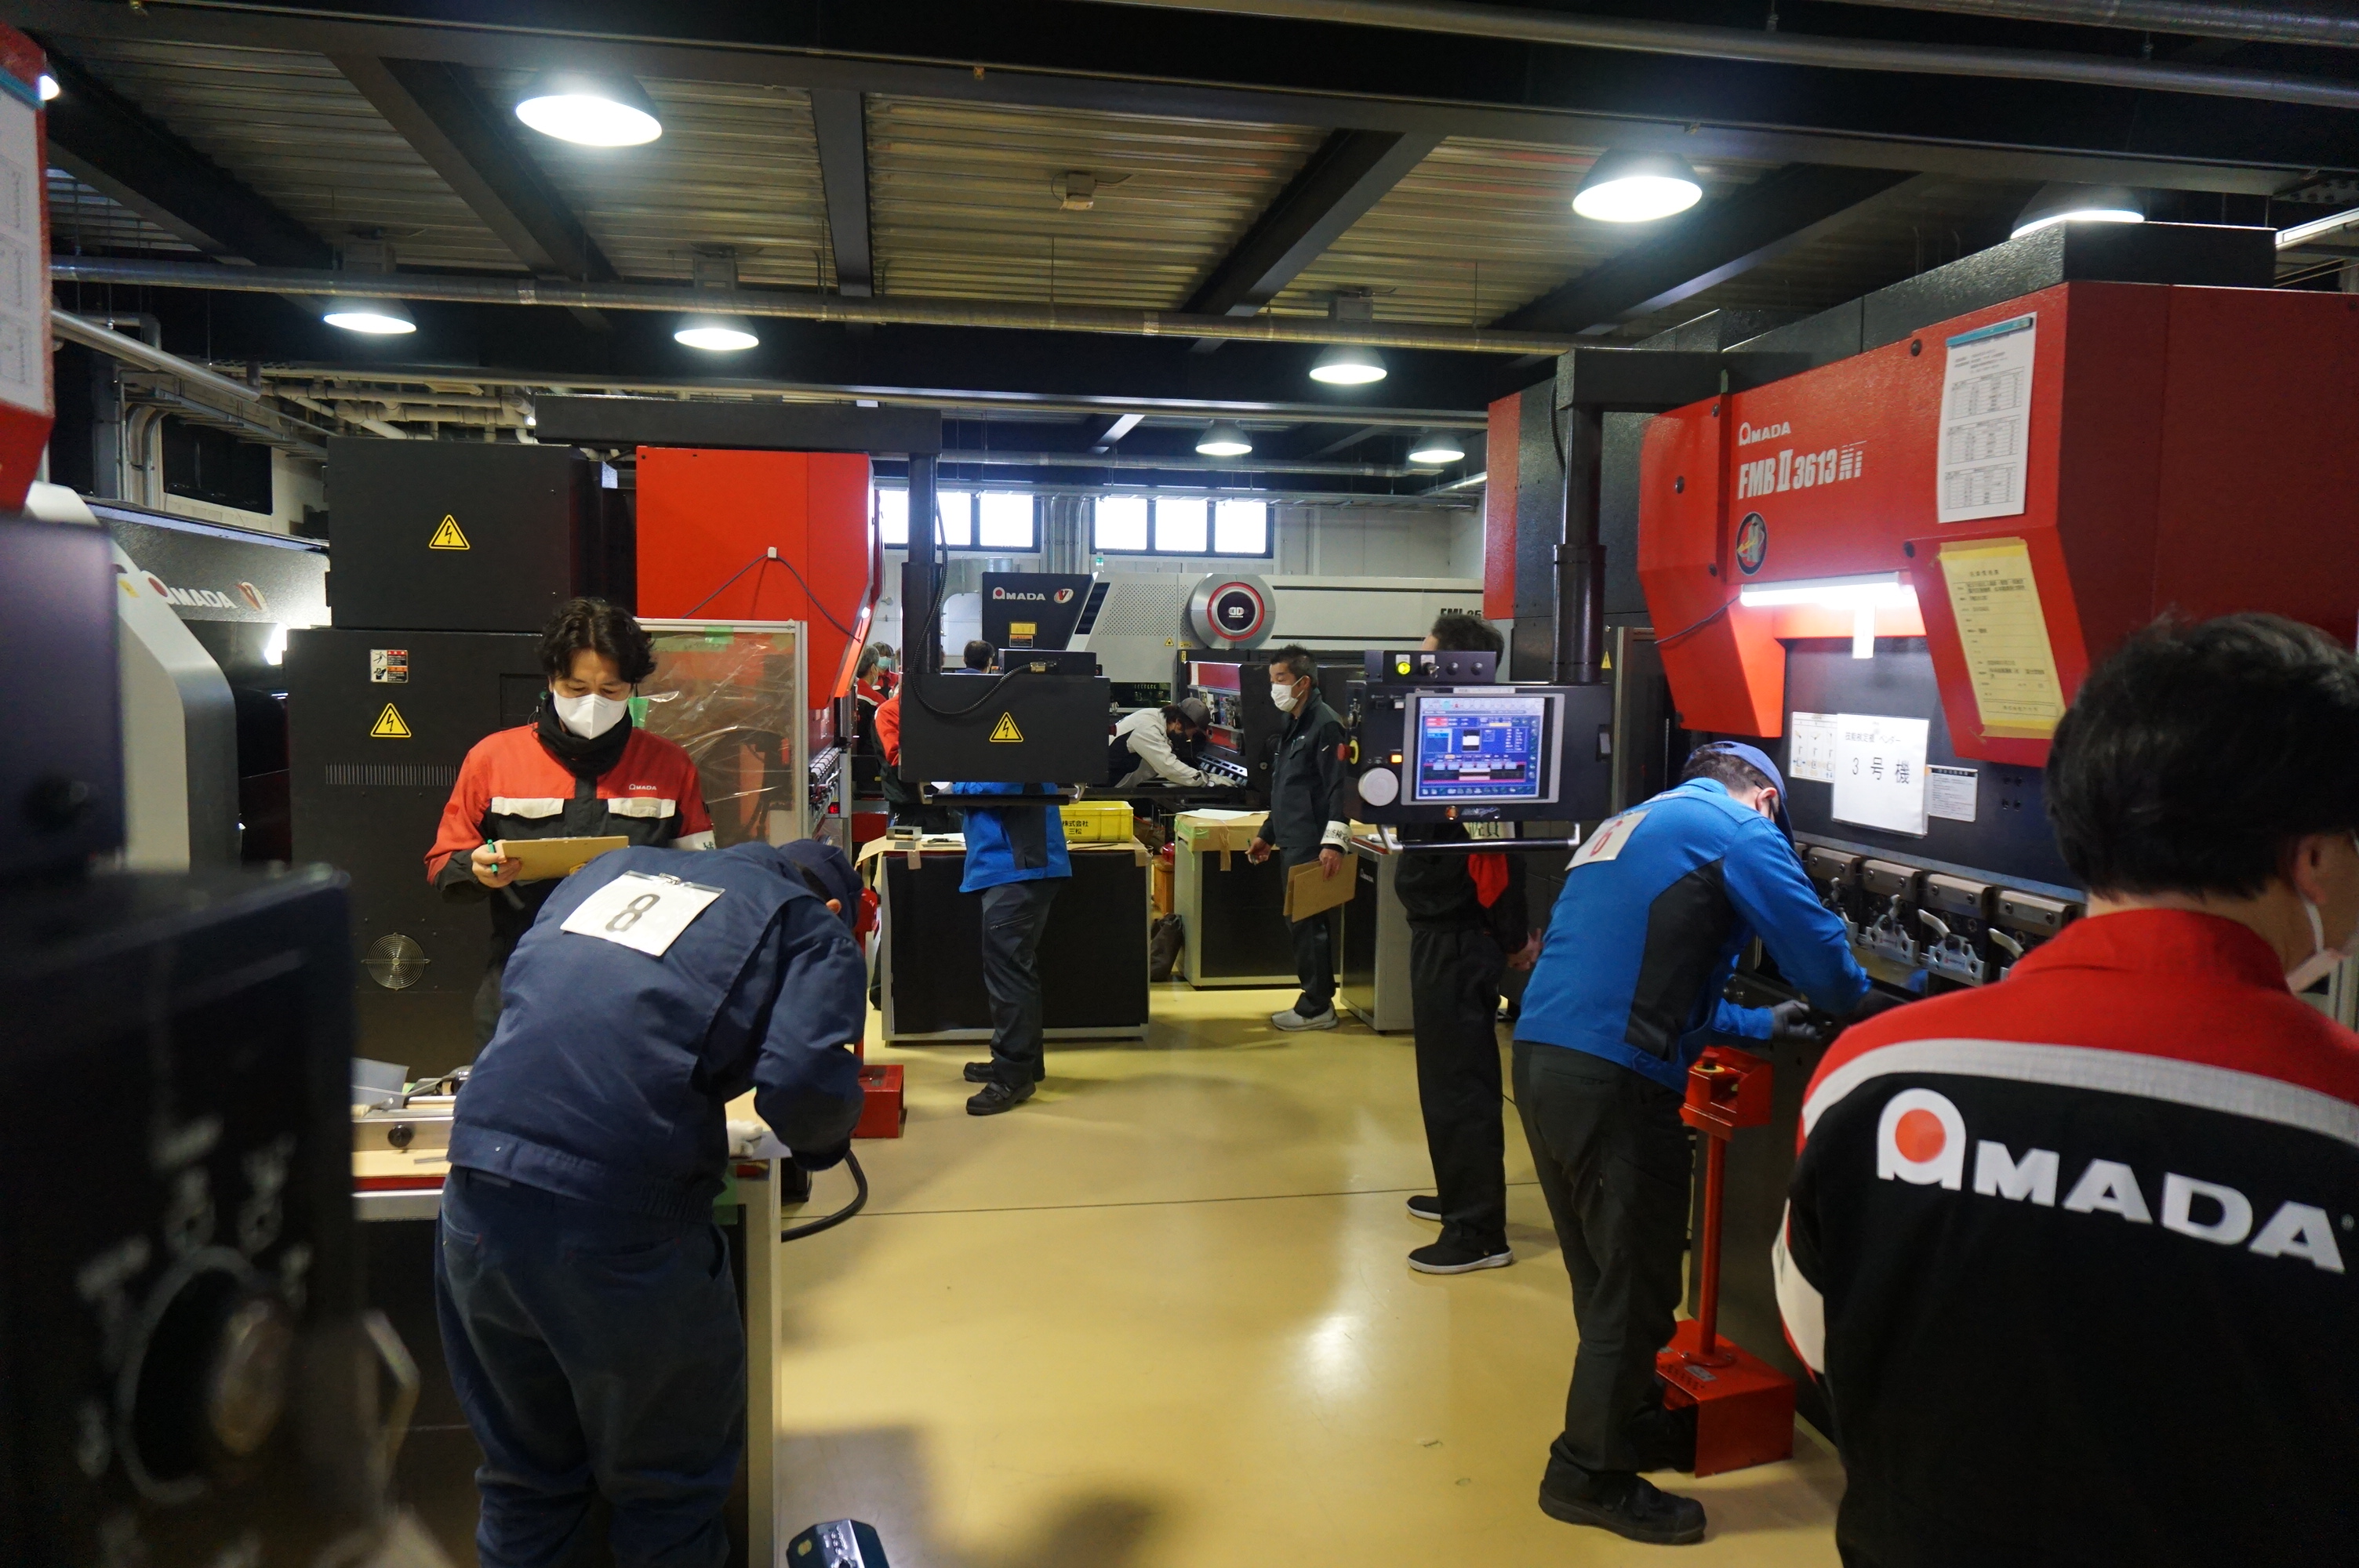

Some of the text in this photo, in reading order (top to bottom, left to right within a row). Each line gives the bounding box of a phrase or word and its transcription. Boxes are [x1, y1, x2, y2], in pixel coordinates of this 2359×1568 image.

[1739, 422, 1791, 446] AMADA
[992, 586, 1046, 601] AMADA
[605, 894, 661, 933] 8
[1877, 1087, 2346, 1275] AMADA
